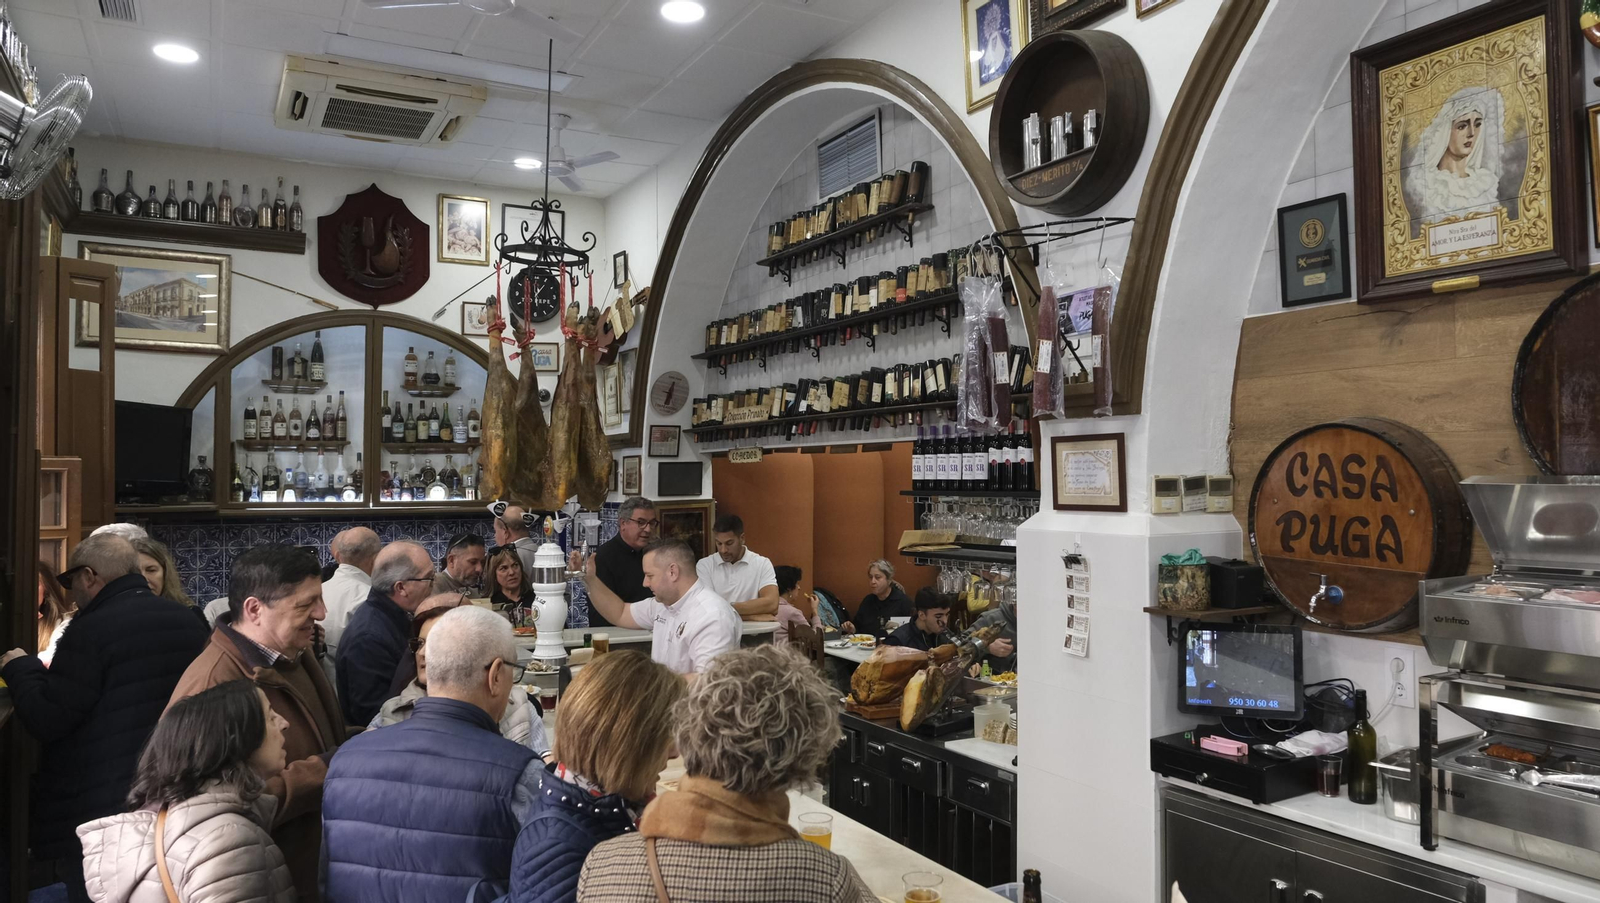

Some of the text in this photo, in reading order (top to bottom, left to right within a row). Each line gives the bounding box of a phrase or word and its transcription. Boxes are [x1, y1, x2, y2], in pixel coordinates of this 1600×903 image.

[1469, 224, 1477, 232] del
[1431, 237, 1448, 247] AMOR
[1463, 229, 1497, 241] ESPERANZA
[1285, 451, 1398, 502] CASA
[1275, 510, 1404, 564] PUGA
[1228, 697, 1243, 706] 950
[1245, 698, 1255, 707] 30
[1256, 699, 1267, 707] 60
[1268, 700, 1279, 708] 48
